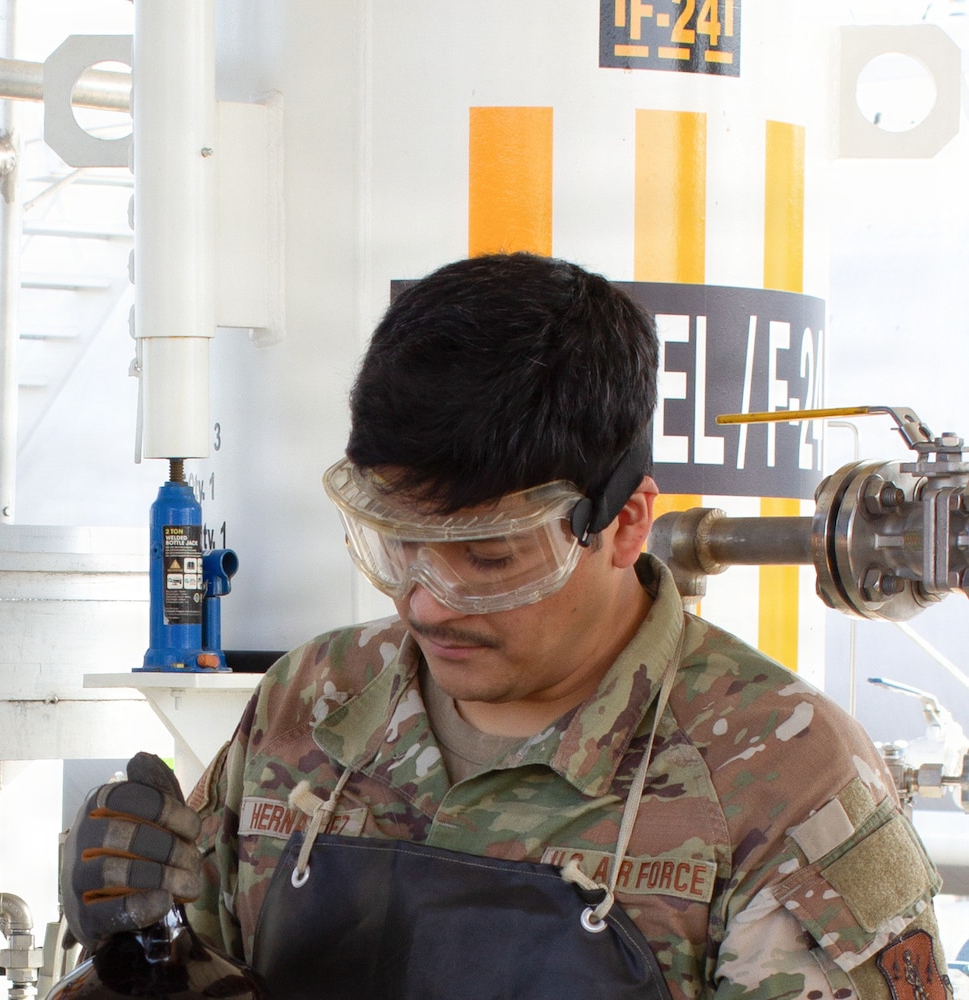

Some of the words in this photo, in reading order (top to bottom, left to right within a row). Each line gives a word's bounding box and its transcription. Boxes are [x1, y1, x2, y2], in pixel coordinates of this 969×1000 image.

[652, 314, 725, 465] EL
[766, 320, 823, 472] F-24
[213, 422, 221, 451] 3
[592, 856, 633, 888] AR
[635, 861, 707, 896] FORCE
